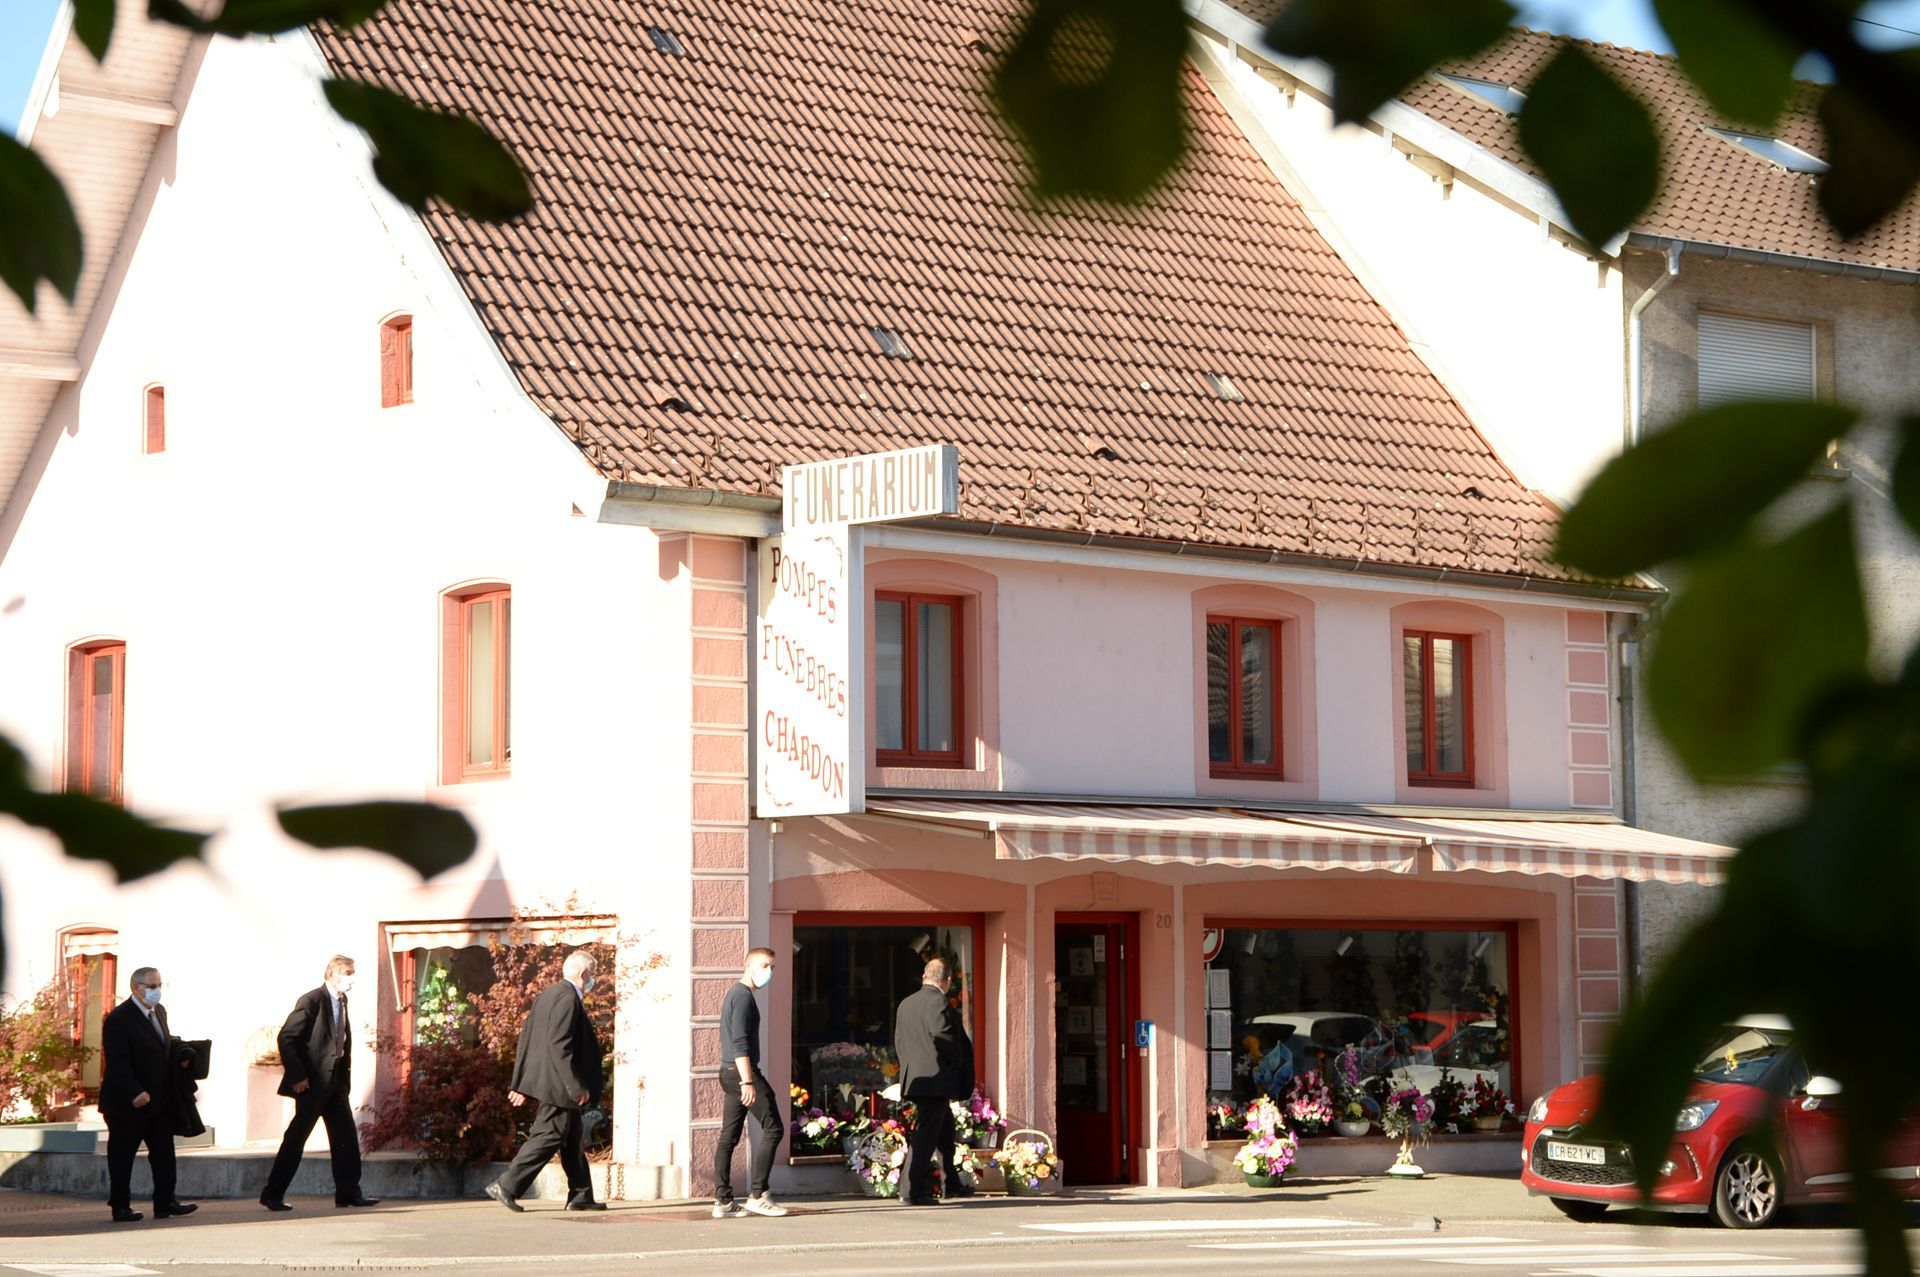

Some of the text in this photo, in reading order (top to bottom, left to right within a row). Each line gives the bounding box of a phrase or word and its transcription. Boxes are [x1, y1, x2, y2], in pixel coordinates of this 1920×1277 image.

[791, 451, 936, 528] FUNERARIUM
[772, 547, 836, 623] POMPES
[763, 625, 845, 717] FUNEBRES
[765, 710, 844, 798] CHARDON
[1156, 913, 1172, 929] 20
